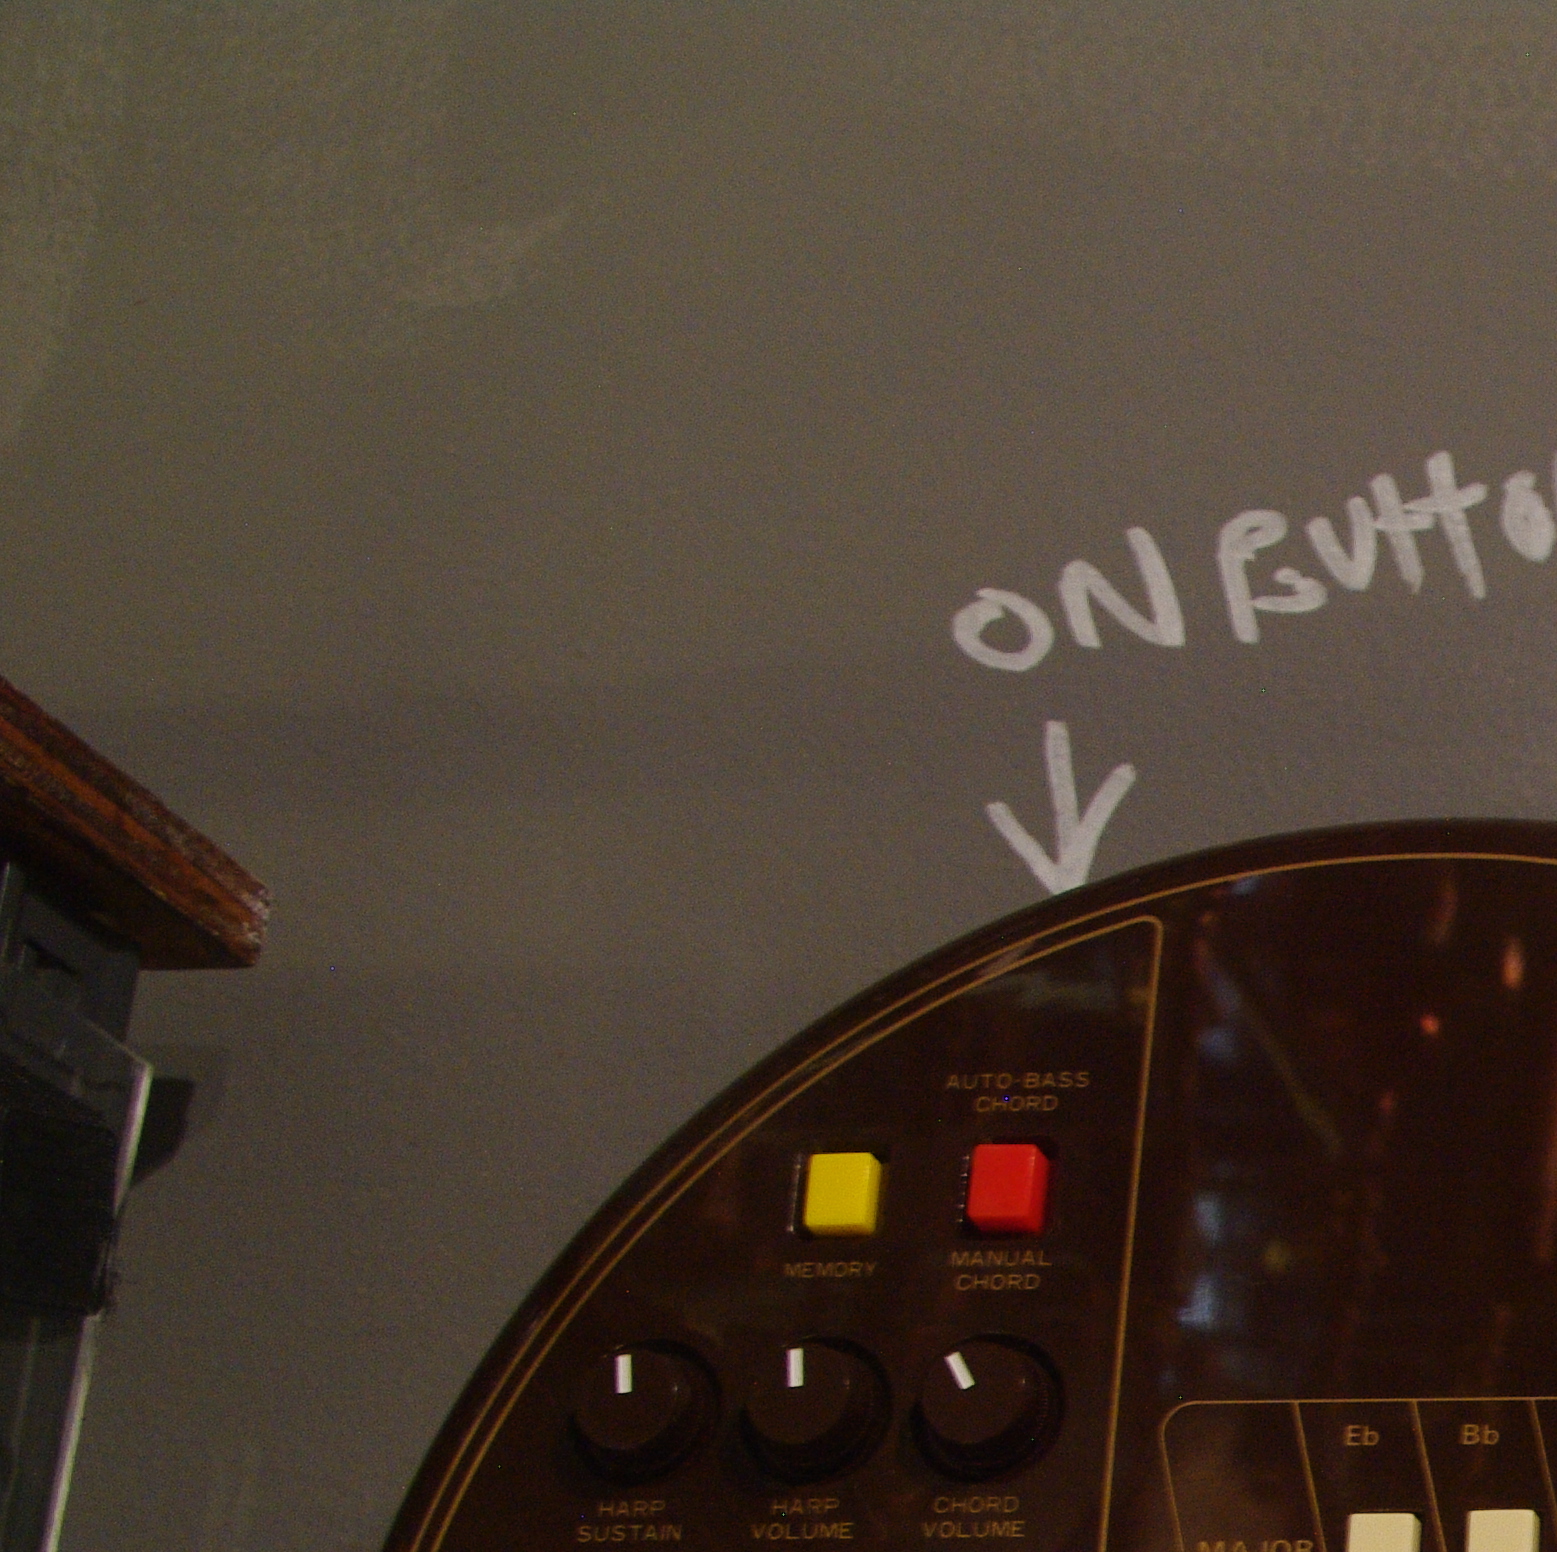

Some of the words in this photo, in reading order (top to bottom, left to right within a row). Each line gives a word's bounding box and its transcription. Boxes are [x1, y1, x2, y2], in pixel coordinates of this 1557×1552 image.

[952, 525, 1187, 673] ON
[946, 1071, 1091, 1092] AUTO-BASS
[974, 1095, 1059, 1113] CHORD
[949, 1250, 1053, 1268] MANUAL
[783, 1260, 878, 1279] MEMORY
[955, 1273, 1042, 1292] CHORD
[1343, 1425, 1381, 1447] Eb
[1459, 1424, 1500, 1446] Bb
[598, 1500, 667, 1518] HARP
[770, 1497, 840, 1516] HARP
[932, 1495, 1020, 1514] CHORD
[576, 1523, 683, 1543] SUSTAIN
[750, 1521, 854, 1540] VOLUME
[921, 1519, 1026, 1538] VOLUME
